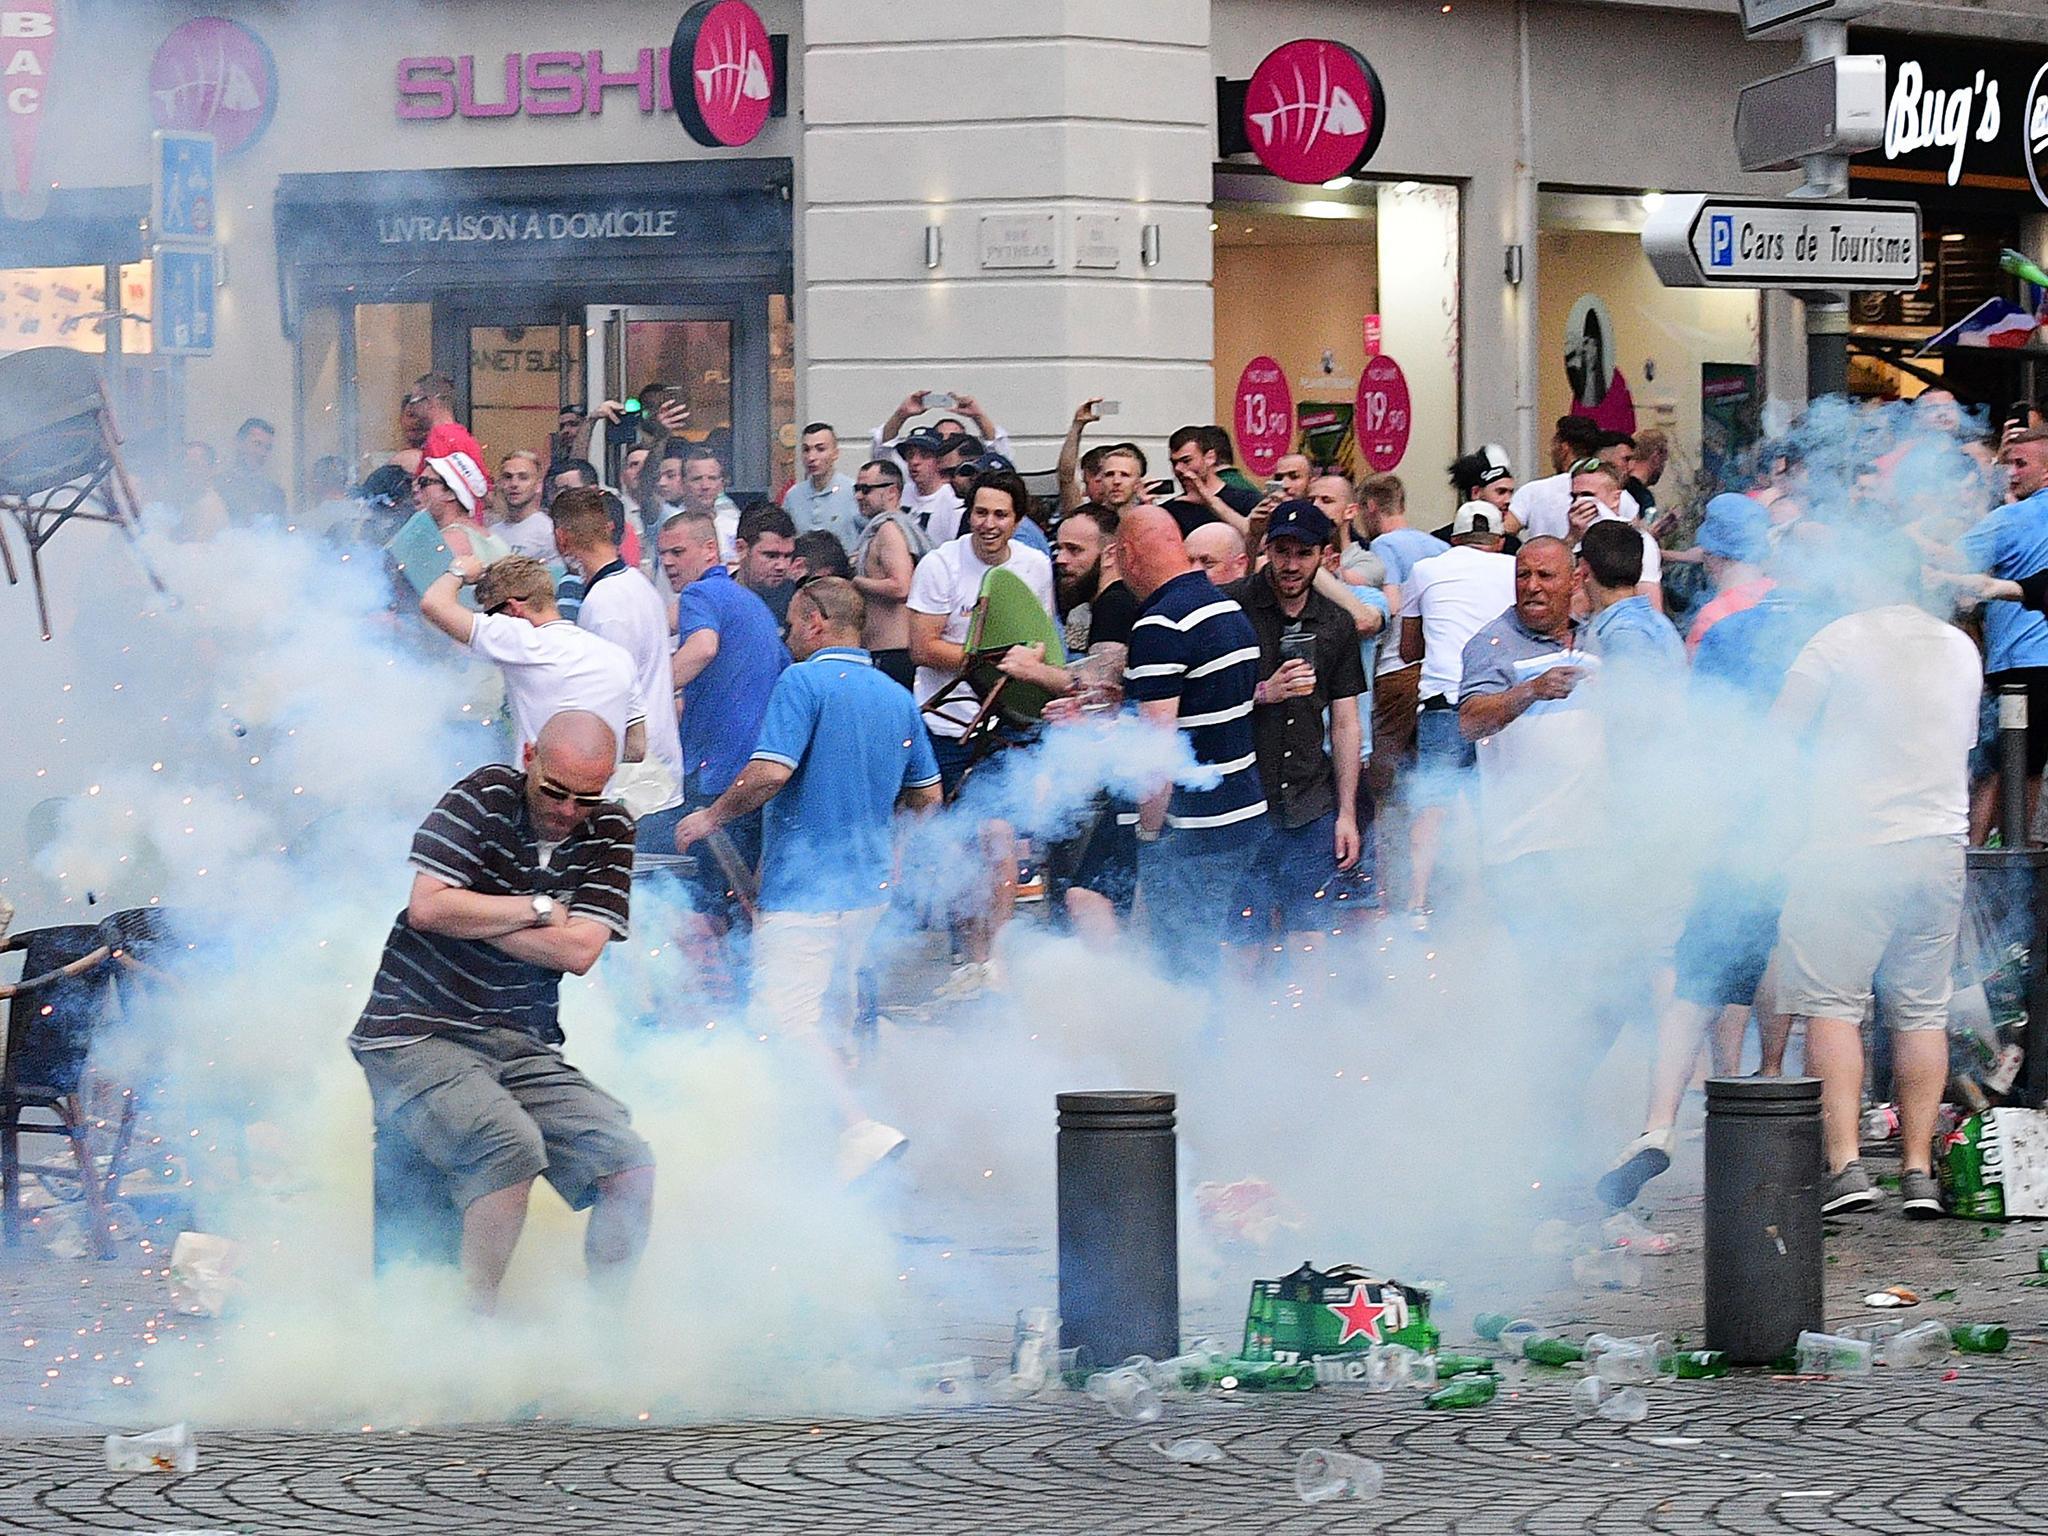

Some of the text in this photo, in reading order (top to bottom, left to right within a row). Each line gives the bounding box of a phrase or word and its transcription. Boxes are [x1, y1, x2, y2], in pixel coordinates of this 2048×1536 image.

[396, 47, 673, 119] SUSHI
[1885, 60, 2001, 187] Bug's
[378, 213, 516, 243] LIVRAISON
[550, 208, 677, 240] DOMICILE
[1741, 222, 1784, 260] Cars
[1795, 225, 1818, 262] de
[1830, 225, 1911, 264] Tourisme
